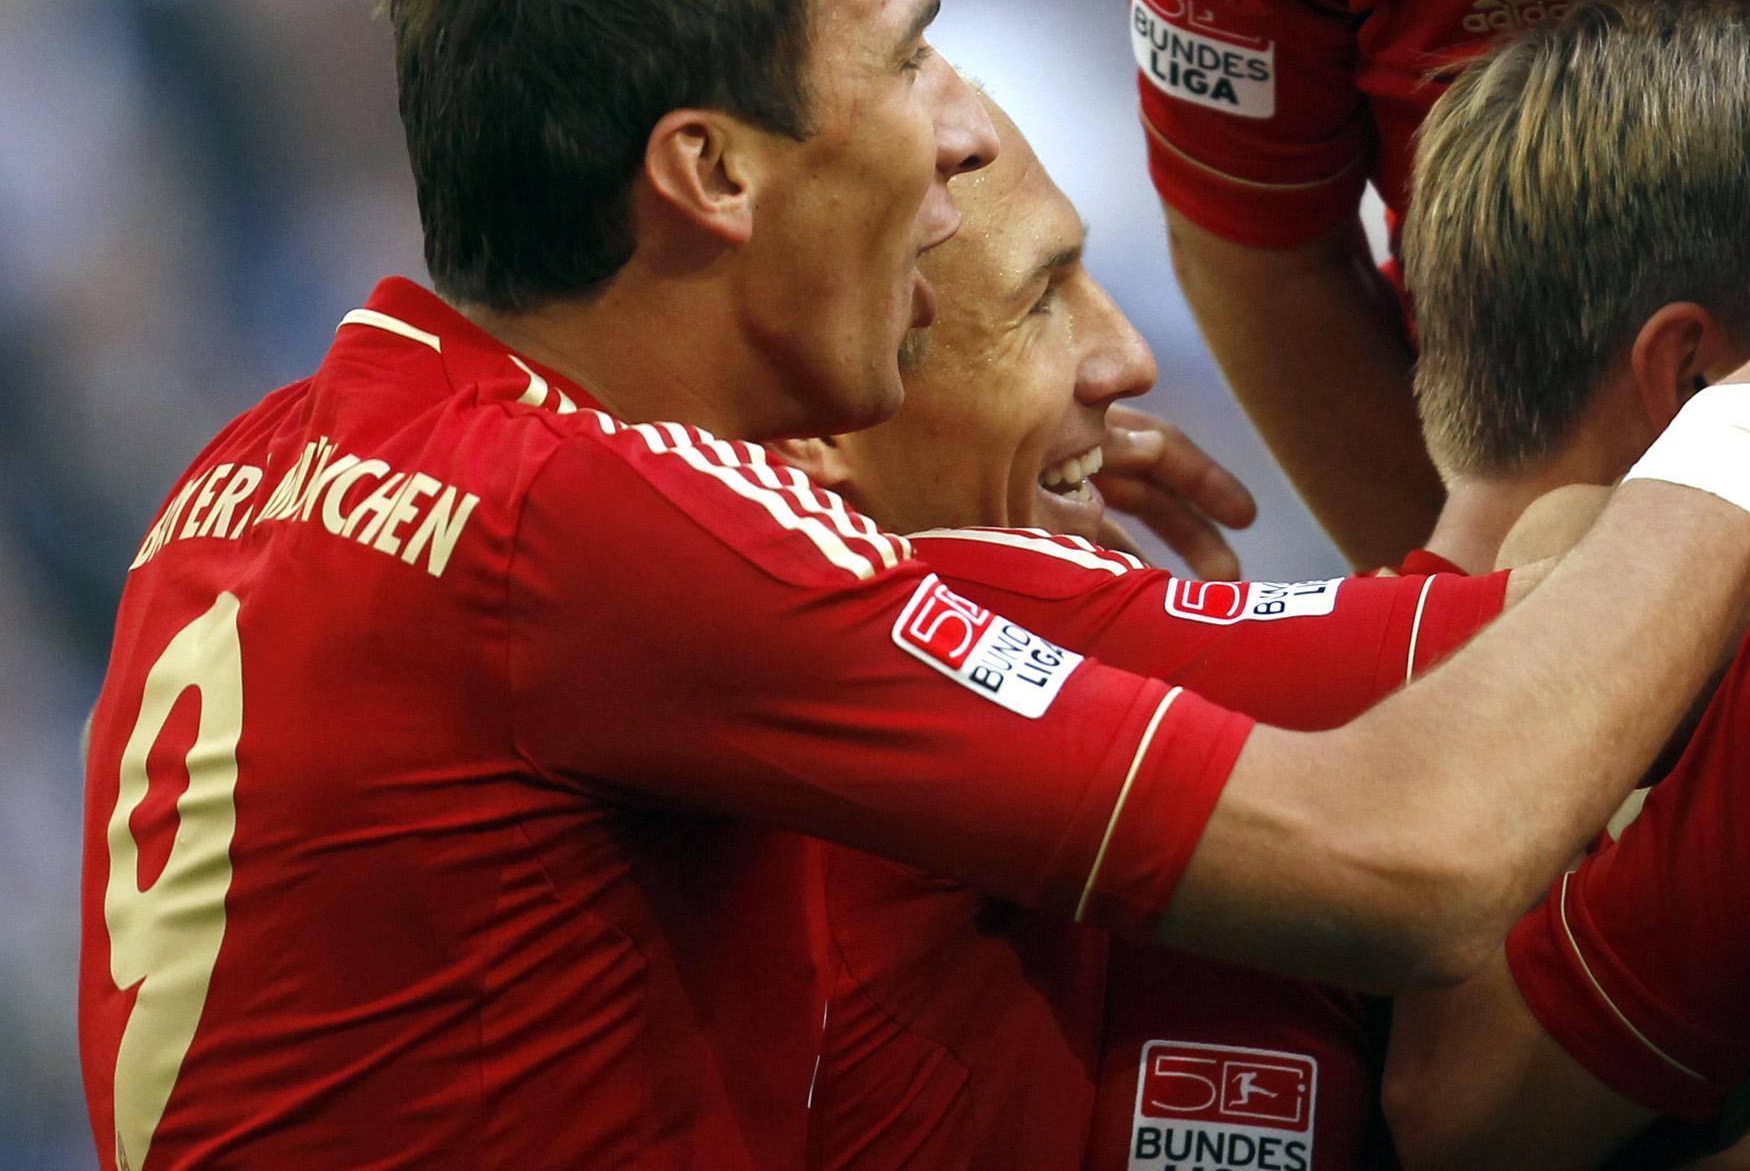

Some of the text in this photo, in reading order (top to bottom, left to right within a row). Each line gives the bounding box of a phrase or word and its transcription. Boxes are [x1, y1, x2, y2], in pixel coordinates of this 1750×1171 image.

[1134, 6, 1270, 82] BUNDES
[1462, 2, 1571, 32] adida
[1151, 51, 1239, 106] LIGA
[104, 591, 242, 1171] 9
[1135, 1127, 1307, 1171] BUNDES
